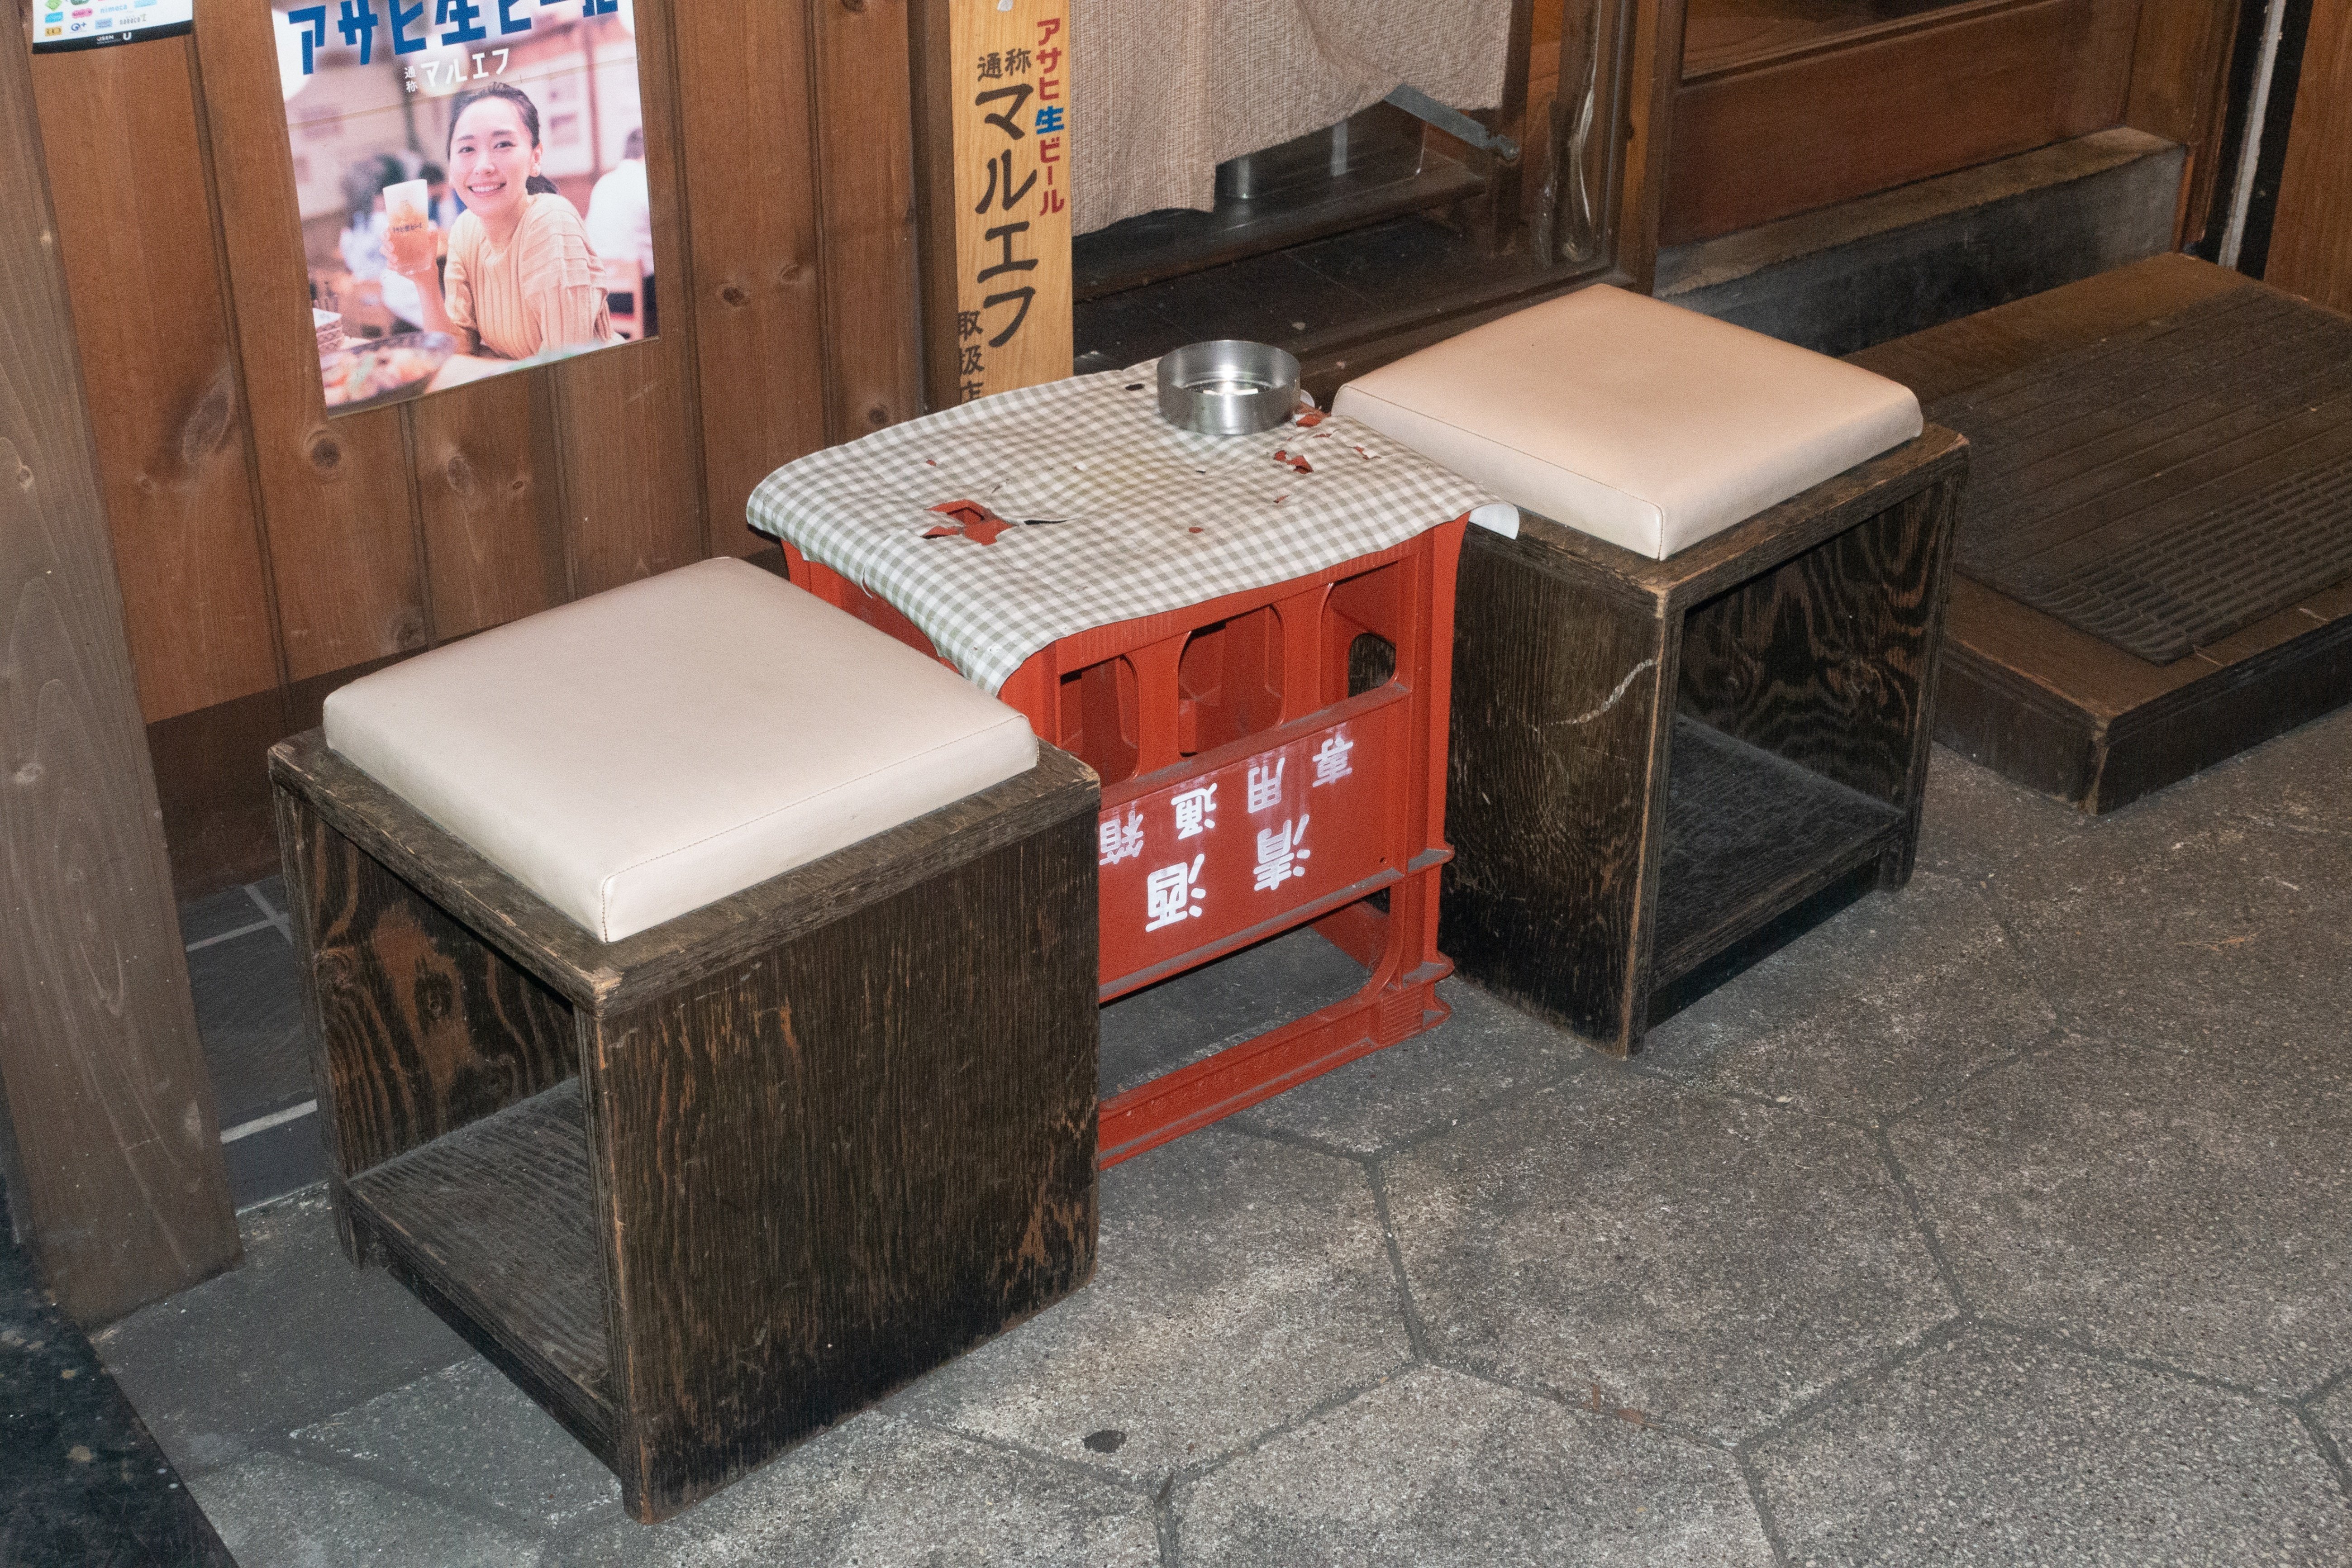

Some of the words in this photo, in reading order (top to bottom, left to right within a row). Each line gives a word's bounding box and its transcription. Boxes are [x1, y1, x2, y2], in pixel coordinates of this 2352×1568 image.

[404, 66, 418, 93] 通称
[421, 48, 509, 87] マルエフ
[977, 48, 1032, 82] 通称
[1035, 18, 1065, 216] アサヒ生ビール
[975, 83, 1039, 348] マルエフ
[1145, 815, 1310, 932] 清酒
